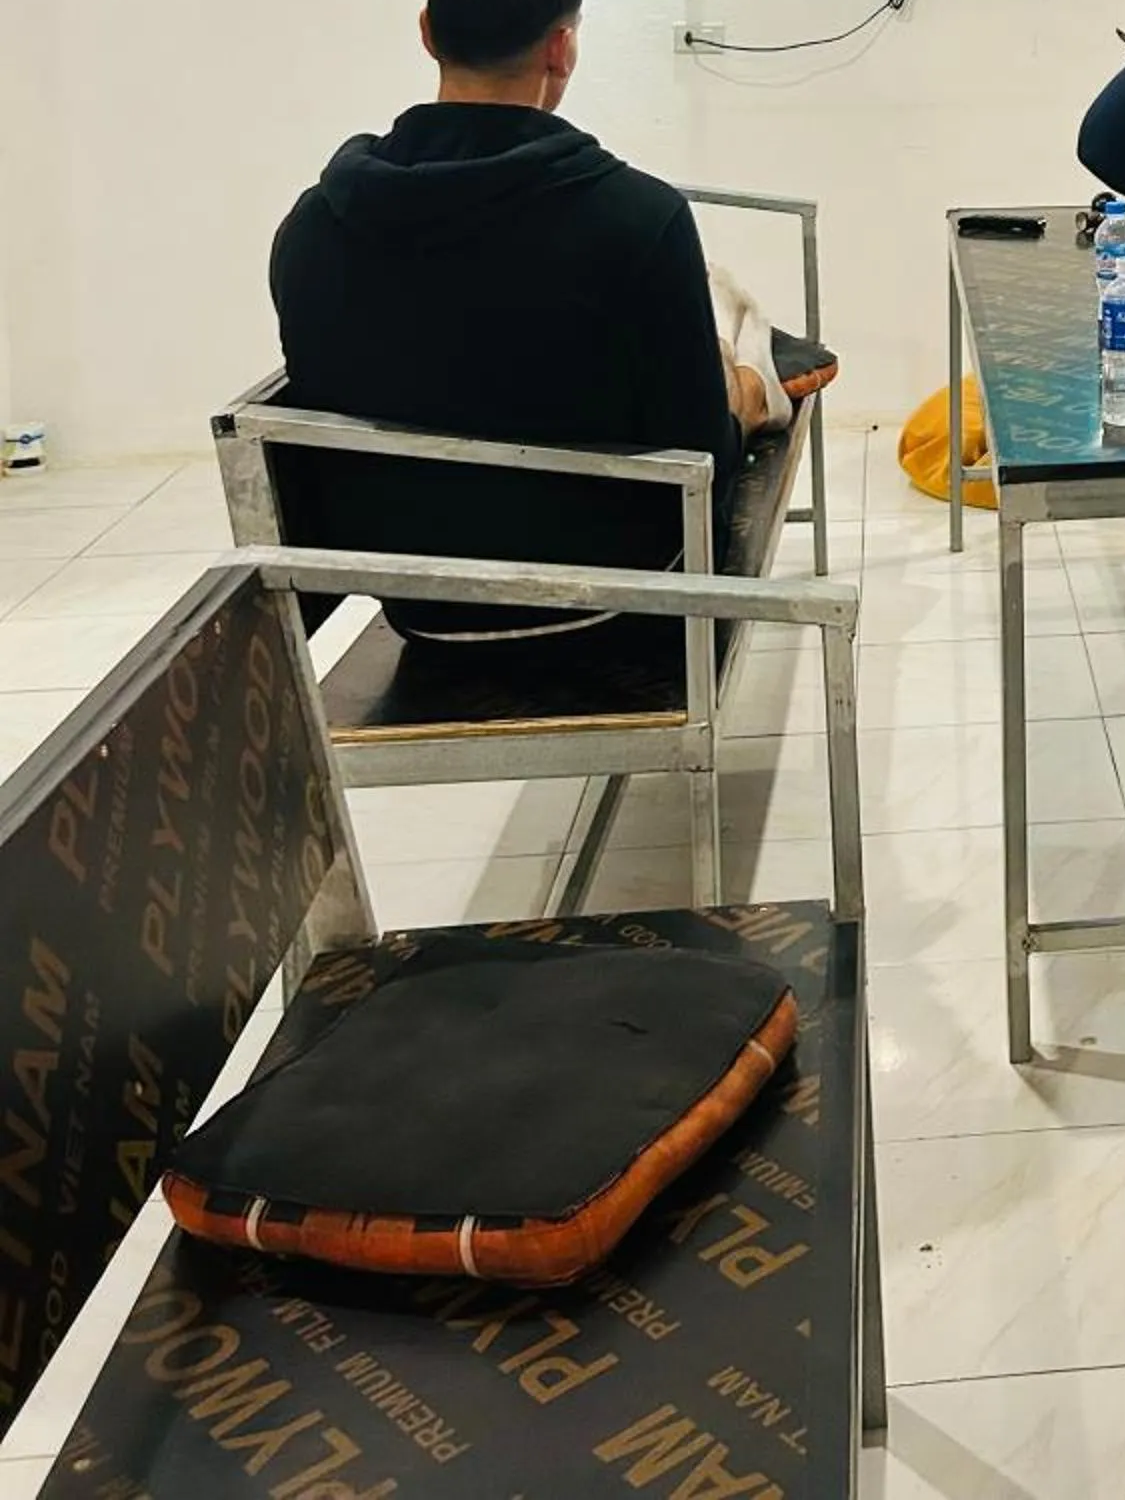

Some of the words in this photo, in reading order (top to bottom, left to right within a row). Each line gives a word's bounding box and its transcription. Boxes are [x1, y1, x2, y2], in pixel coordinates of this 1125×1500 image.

[56, 1108, 86, 1215] VIET
[75, 989, 101, 1096] NAM
[271, 1297, 349, 1355] FILM
[333, 1349, 474, 1465] PREMIUM
[705, 1364, 792, 1428] NAM
